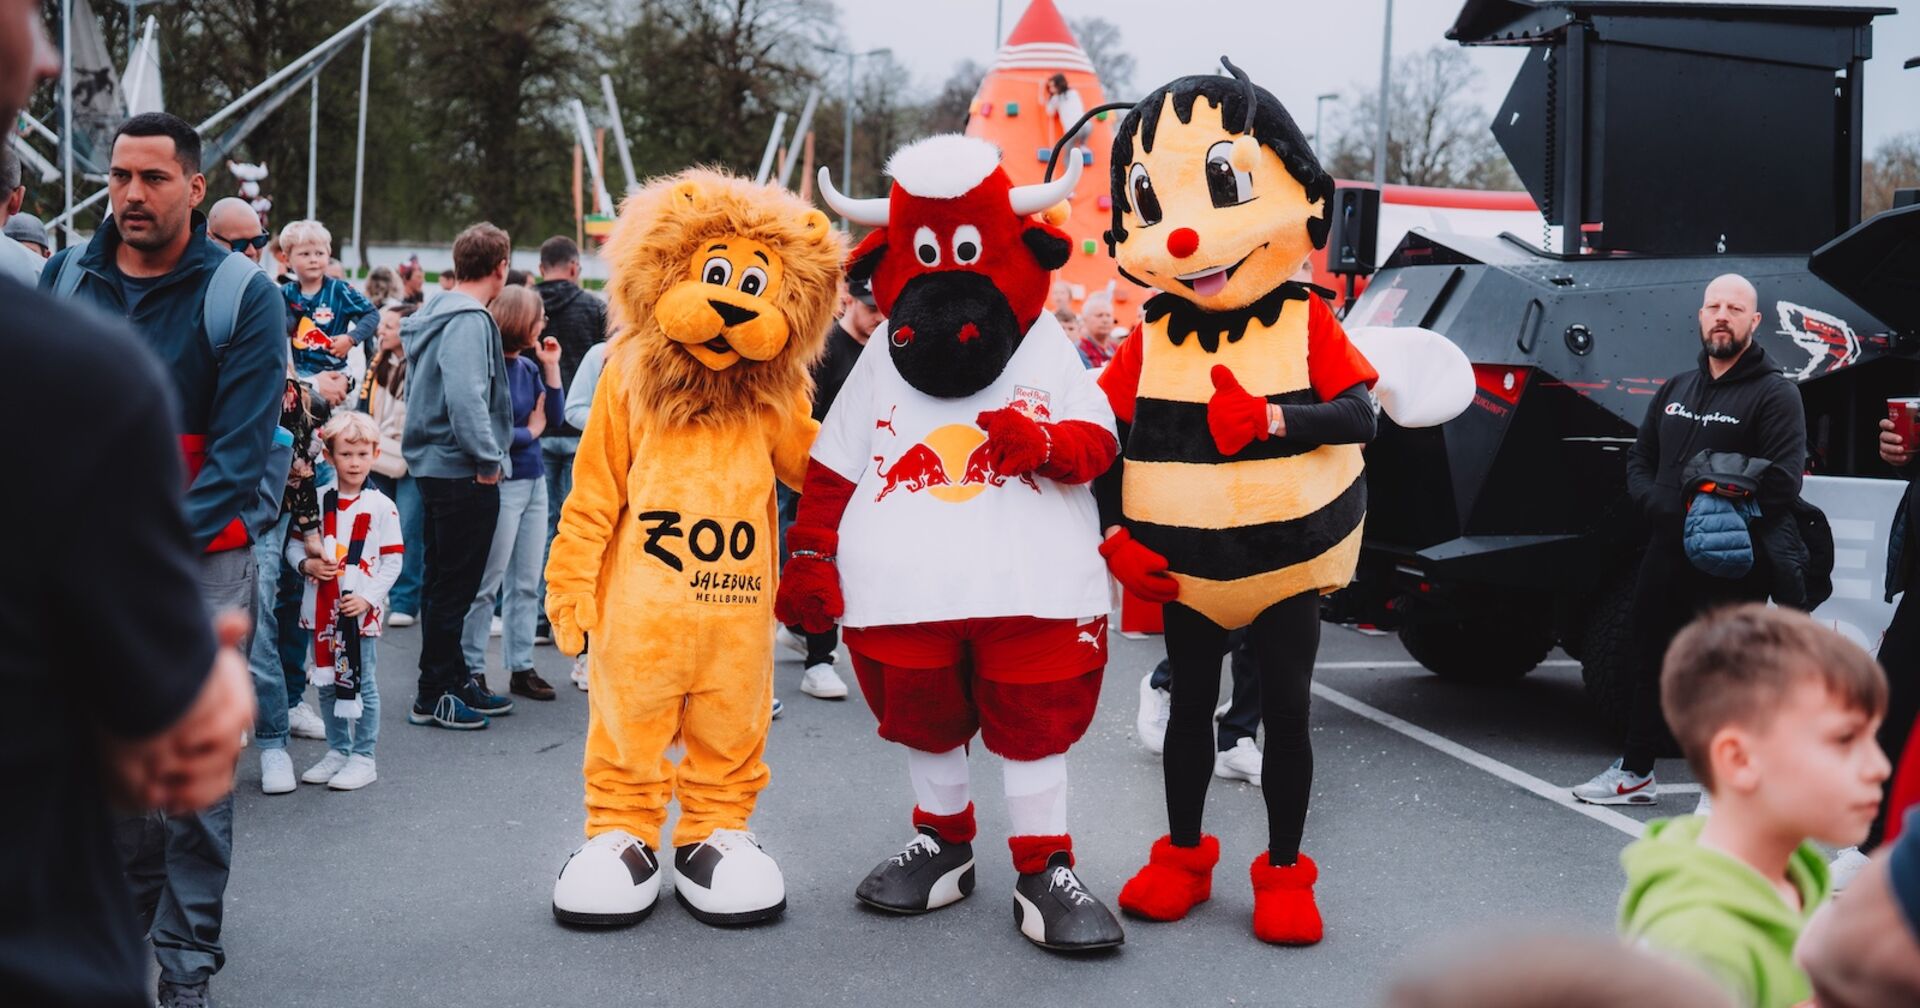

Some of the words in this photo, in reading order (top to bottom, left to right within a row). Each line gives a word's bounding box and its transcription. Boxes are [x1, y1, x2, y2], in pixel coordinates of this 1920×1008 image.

[1016, 387, 1033, 397] Red
[1034, 390, 1050, 403] Bull
[638, 510, 756, 572] ZOO
[690, 570, 762, 591] SALZBURG
[696, 592, 758, 605] HELLBRUNN
